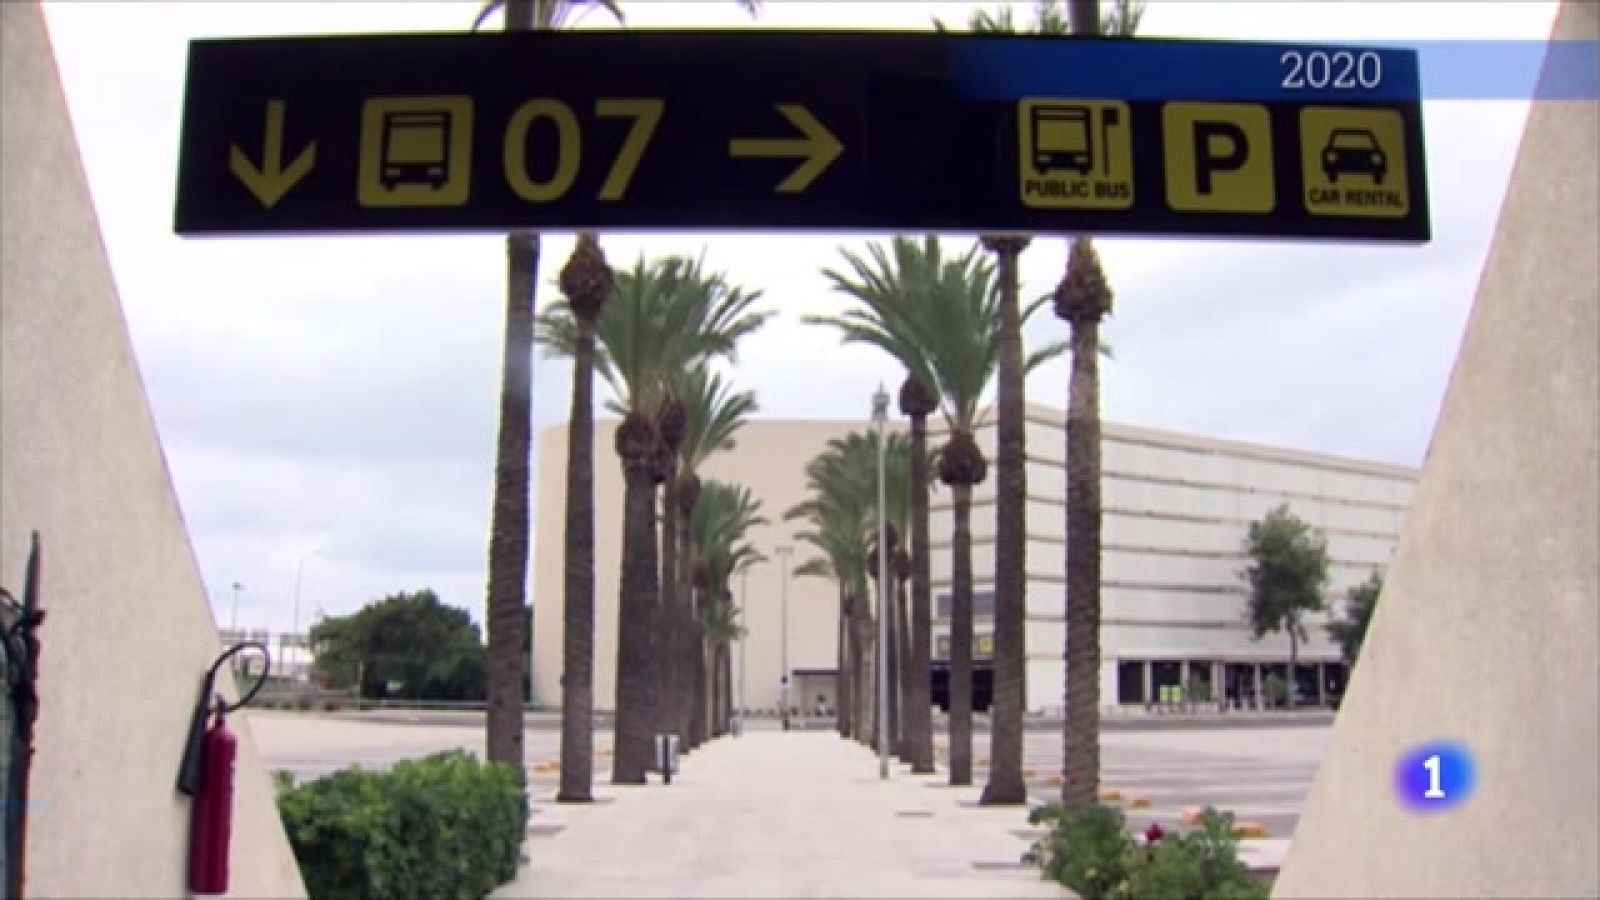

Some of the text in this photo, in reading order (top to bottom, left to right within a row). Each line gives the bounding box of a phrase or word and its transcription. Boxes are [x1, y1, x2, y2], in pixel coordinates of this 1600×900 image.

[504, 98, 665, 202] 07
[1193, 119, 1249, 196] P
[1024, 180, 1130, 199] PUBLIC BUS
[1309, 189, 1403, 208] CAR RENTAL
